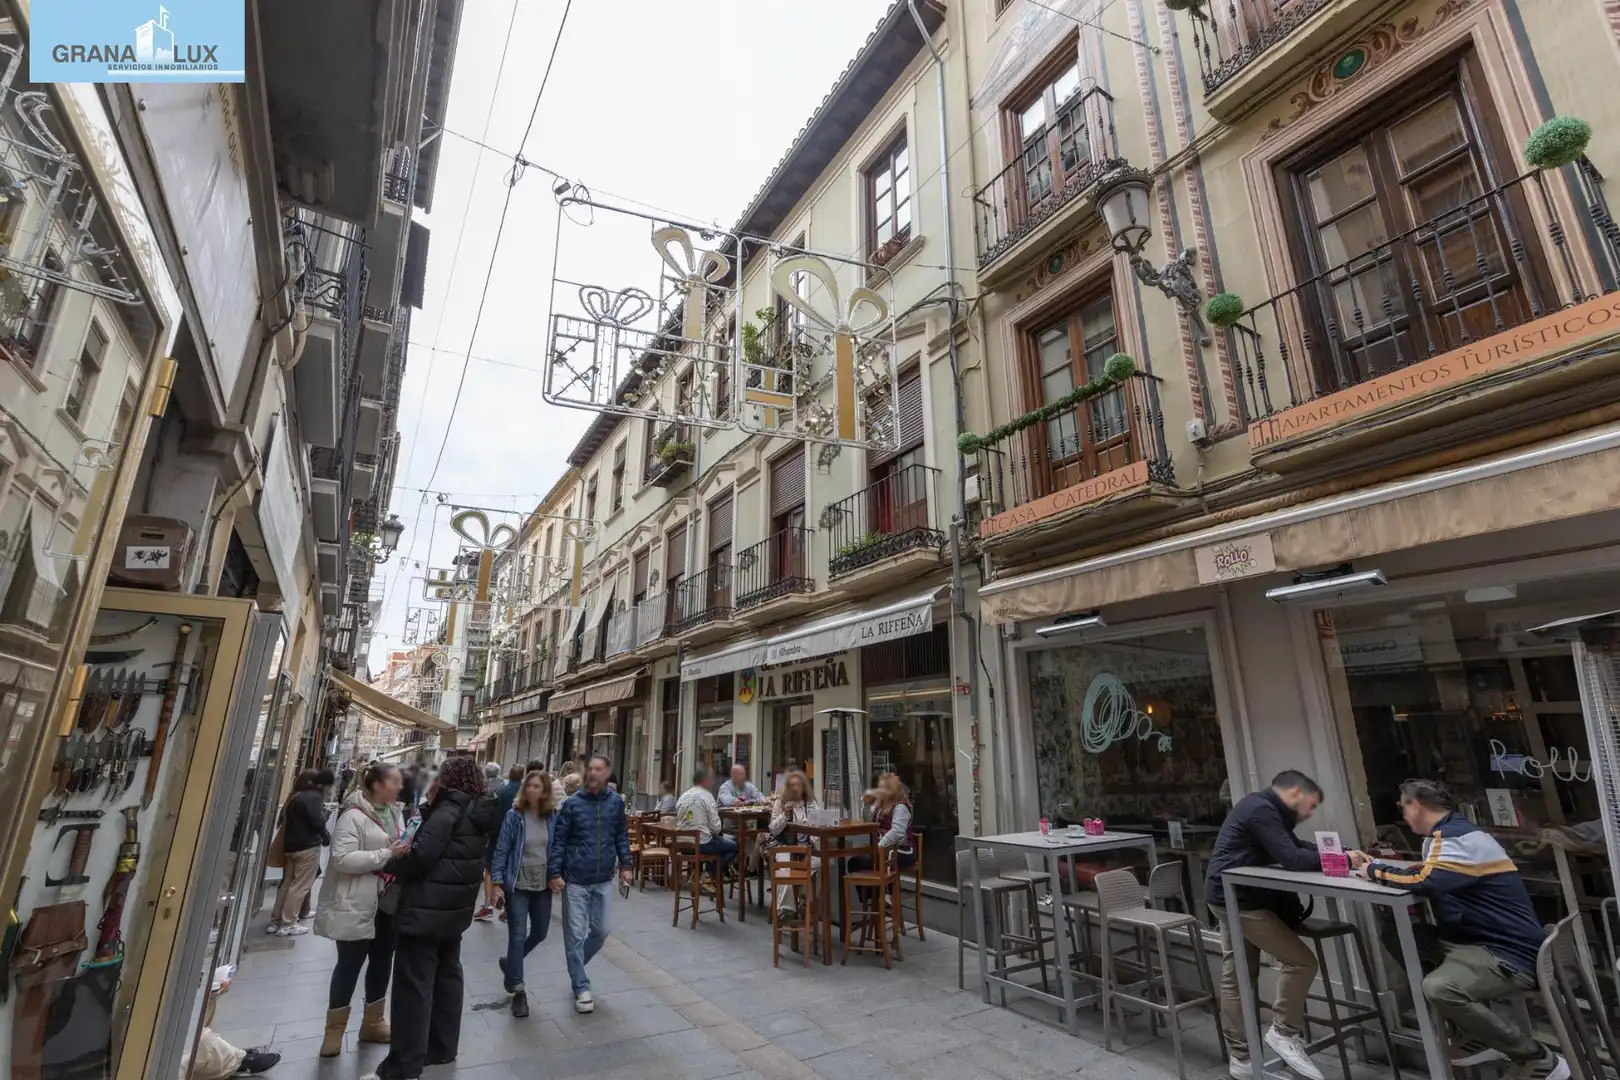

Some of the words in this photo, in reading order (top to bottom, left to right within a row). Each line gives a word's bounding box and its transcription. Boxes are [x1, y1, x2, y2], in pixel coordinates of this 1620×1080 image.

[1282, 363, 1451, 433] APARTAMENTOS
[1456, 302, 1620, 370] TURÍSTICOS
[998, 507, 1036, 531] CASA
[1052, 467, 1143, 510] CATEDRAL
[1215, 548, 1249, 570] ROLLO
[861, 626, 875, 639] LA
[878, 613, 924, 635] RIFFEÑA
[758, 676, 777, 698] LA
[782, 658, 850, 695] RIFFEÑA
[1490, 739, 1592, 782] Roll
